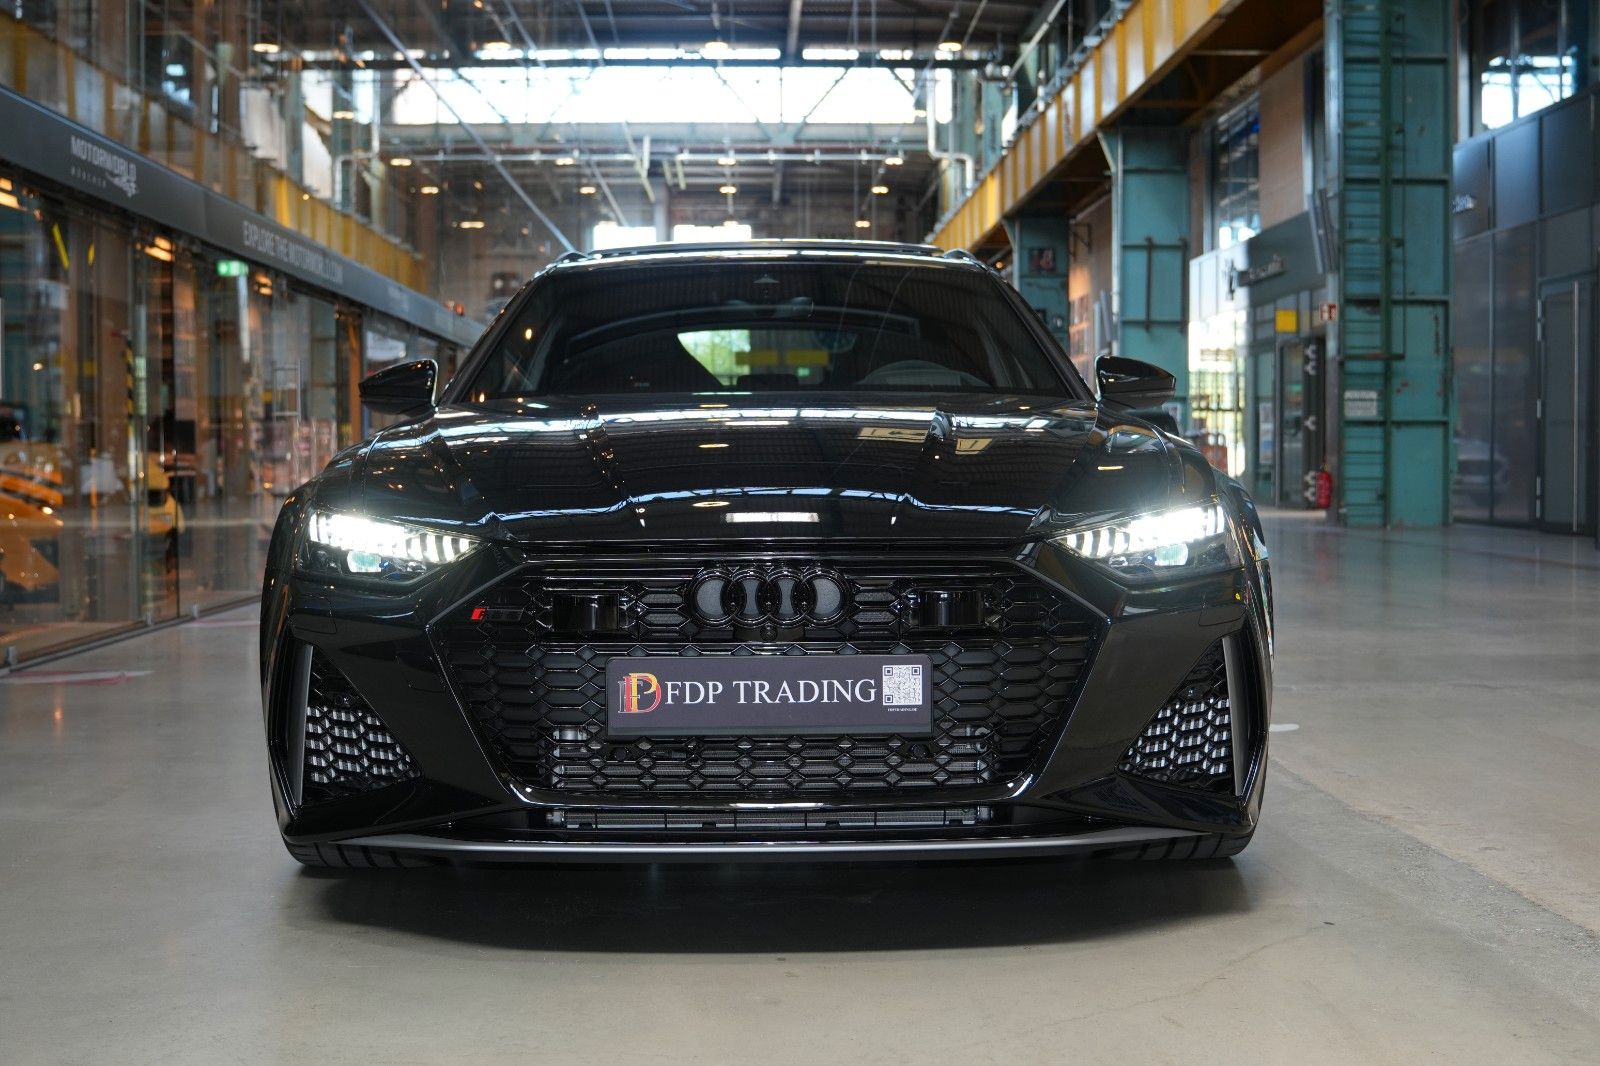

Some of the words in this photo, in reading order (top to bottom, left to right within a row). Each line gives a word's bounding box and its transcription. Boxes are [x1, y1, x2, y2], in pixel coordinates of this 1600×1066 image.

[70, 134, 137, 183] MOTORWORLD
[242, 220, 275, 256] EXPLORE
[275, 234, 288, 262] THE
[665, 681, 722, 704] FDP
[733, 679, 877, 704] TRADING
